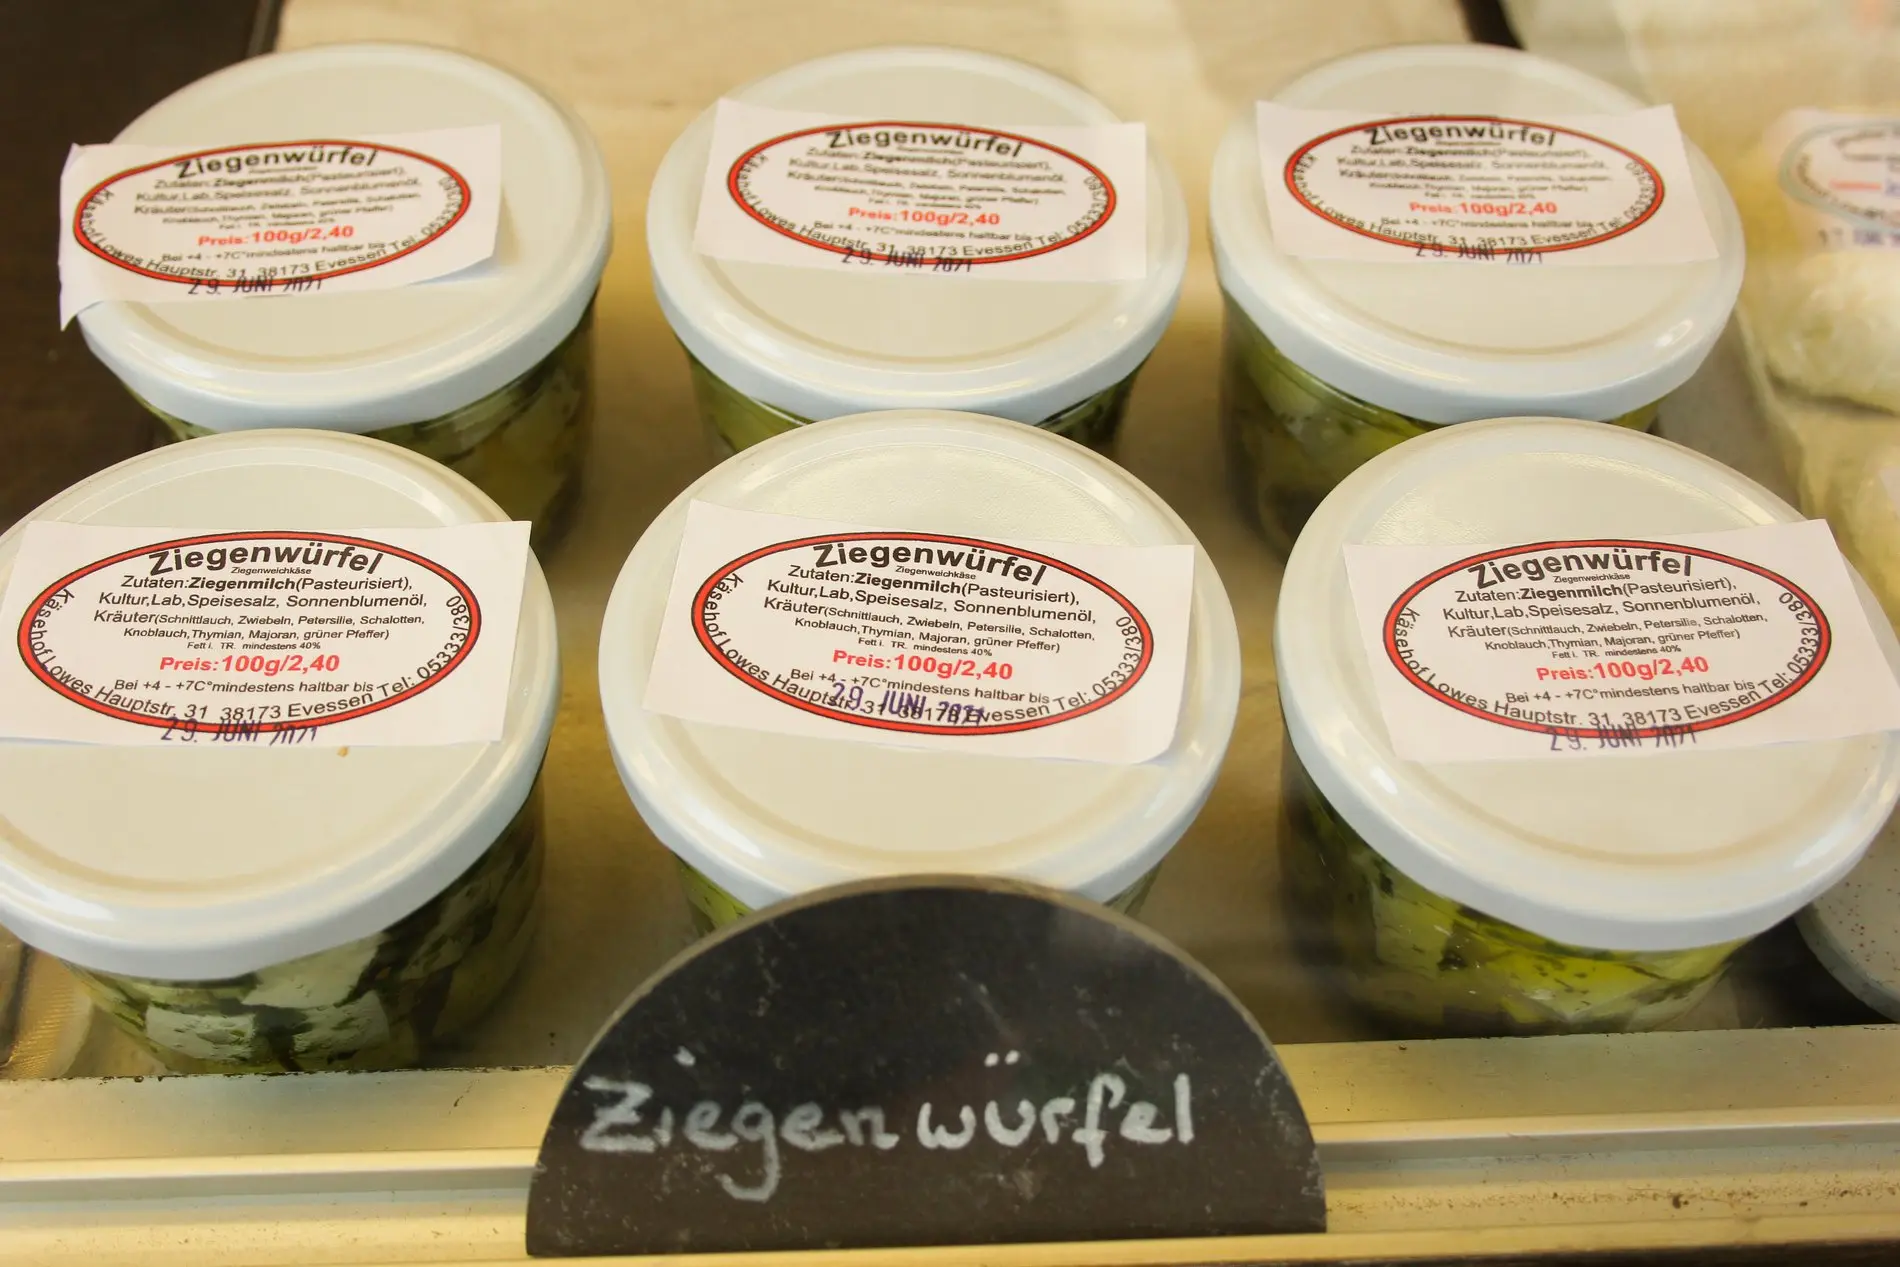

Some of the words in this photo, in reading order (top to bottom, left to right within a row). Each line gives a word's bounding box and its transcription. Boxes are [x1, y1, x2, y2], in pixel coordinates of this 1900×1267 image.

[825, 130, 1023, 157] Ziegenwürfel
[1364, 122, 1556, 147] Ziegenwürfel
[176, 145, 379, 179] Ziegenwürfel
[149, 542, 384, 576] Ziegenwürfel
[231, 566, 312, 576] Ziegenweichkäse
[813, 543, 1047, 586] Ziegenwürfel
[1468, 548, 1691, 590] Ziegenwürfel
[121, 575, 412, 591] Zutaten:Ziegenmilch(Pasteurisiert),
[787, 564, 1079, 605] Zutaten:Ziegenmilch(Pasteurisiert),
[895, 565, 976, 580] Ziegenweichkäse
[1553, 572, 1630, 583] Ziegenweichkäse
[286, 593, 427, 608] Sonnenblumenöl,
[1455, 576, 1737, 603] Zutaten:Ziegenmilch(Pasteurisiert),
[704, 572, 744, 645] Käsehof
[954, 599, 1096, 624] Sonnenblumenöl,
[1623, 592, 1760, 613] Sonnenblumenöl,
[31, 588, 75, 658] Käsehof
[94, 610, 234, 625] Kräuter(Schnittlauch,
[238, 616, 293, 626] Zwiebeln,
[298, 616, 355, 626] Petersilie,
[360, 615, 425, 625] Schalotten,
[763, 596, 903, 626] Kräuter(Schnittlauch,
[907, 616, 963, 631] Zwiebeln,
[967, 621, 1025, 636] Petersilie,
[1029, 626, 1095, 641] Schalotten,
[1448, 623, 1584, 638] Kräuter(Schnittlauch,
[1587, 621, 1642, 633] Zwiebeln,
[1644, 618, 1701, 629] Petersilie,
[1703, 613, 1768, 625] Schalotten,
[242, 642, 297, 650] mindestens
[299, 642, 321, 650] 40%
[249, 630, 299, 641] Majoran,
[303, 630, 343, 641] grüner
[346, 629, 390, 640] Pfeffer)
[416, 595, 470, 679] 05333/380
[919, 631, 970, 646] Majoran,
[974, 636, 1014, 649] grüner
[1016, 639, 1060, 653] Pfeffer)
[1604, 635, 1652, 647] Majoran,
[1658, 633, 1695, 645] grüner
[1697, 629, 1741, 641] Pfeffer)
[717, 638, 770, 682] Lowes
[913, 643, 968, 655] mindestens
[971, 648, 993, 656] 40%
[1092, 616, 1141, 697] 05333/380
[1396, 607, 1430, 676] Käsehof
[1424, 673, 1488, 711] Lowes
[1494, 700, 1582, 726] Hauptstr.
[1622, 708, 1682, 727] 38173
[1683, 690, 1762, 720] Evessen
[1758, 671, 1793, 694] Tel:
[1778, 592, 1819, 673] 05333/380
[1605, 647, 1658, 657] mindestens
[1659, 644, 1682, 653] 40%
[40, 655, 94, 695] Lowes
[160, 653, 340, 677] Preis:100g/2,40
[832, 649, 1013, 681] Preis:100g/2,40
[1536, 656, 1709, 681] Preis:100g/2,40
[114, 680, 138, 691] Bei
[143, 681, 161, 691] +4
[299, 681, 349, 693] haltbar
[353, 681, 374, 692] bis
[376, 676, 415, 698] Tel:
[790, 668, 814, 681] Bei
[974, 687, 1025, 702] haltbar
[1028, 692, 1050, 704] bis
[1505, 692, 1529, 703] Bei
[1533, 691, 1551, 701] +4
[1683, 682, 1735, 694] haltbar
[1733, 681, 1755, 692] bis
[94, 685, 177, 716] Hauptstr.
[220, 705, 281, 721] 38173
[287, 693, 373, 718] Evessen
[1054, 690, 1091, 712] Tel:
[212, 720, 262, 742] JUNI
[1599, 723, 1641, 748] JUNI
